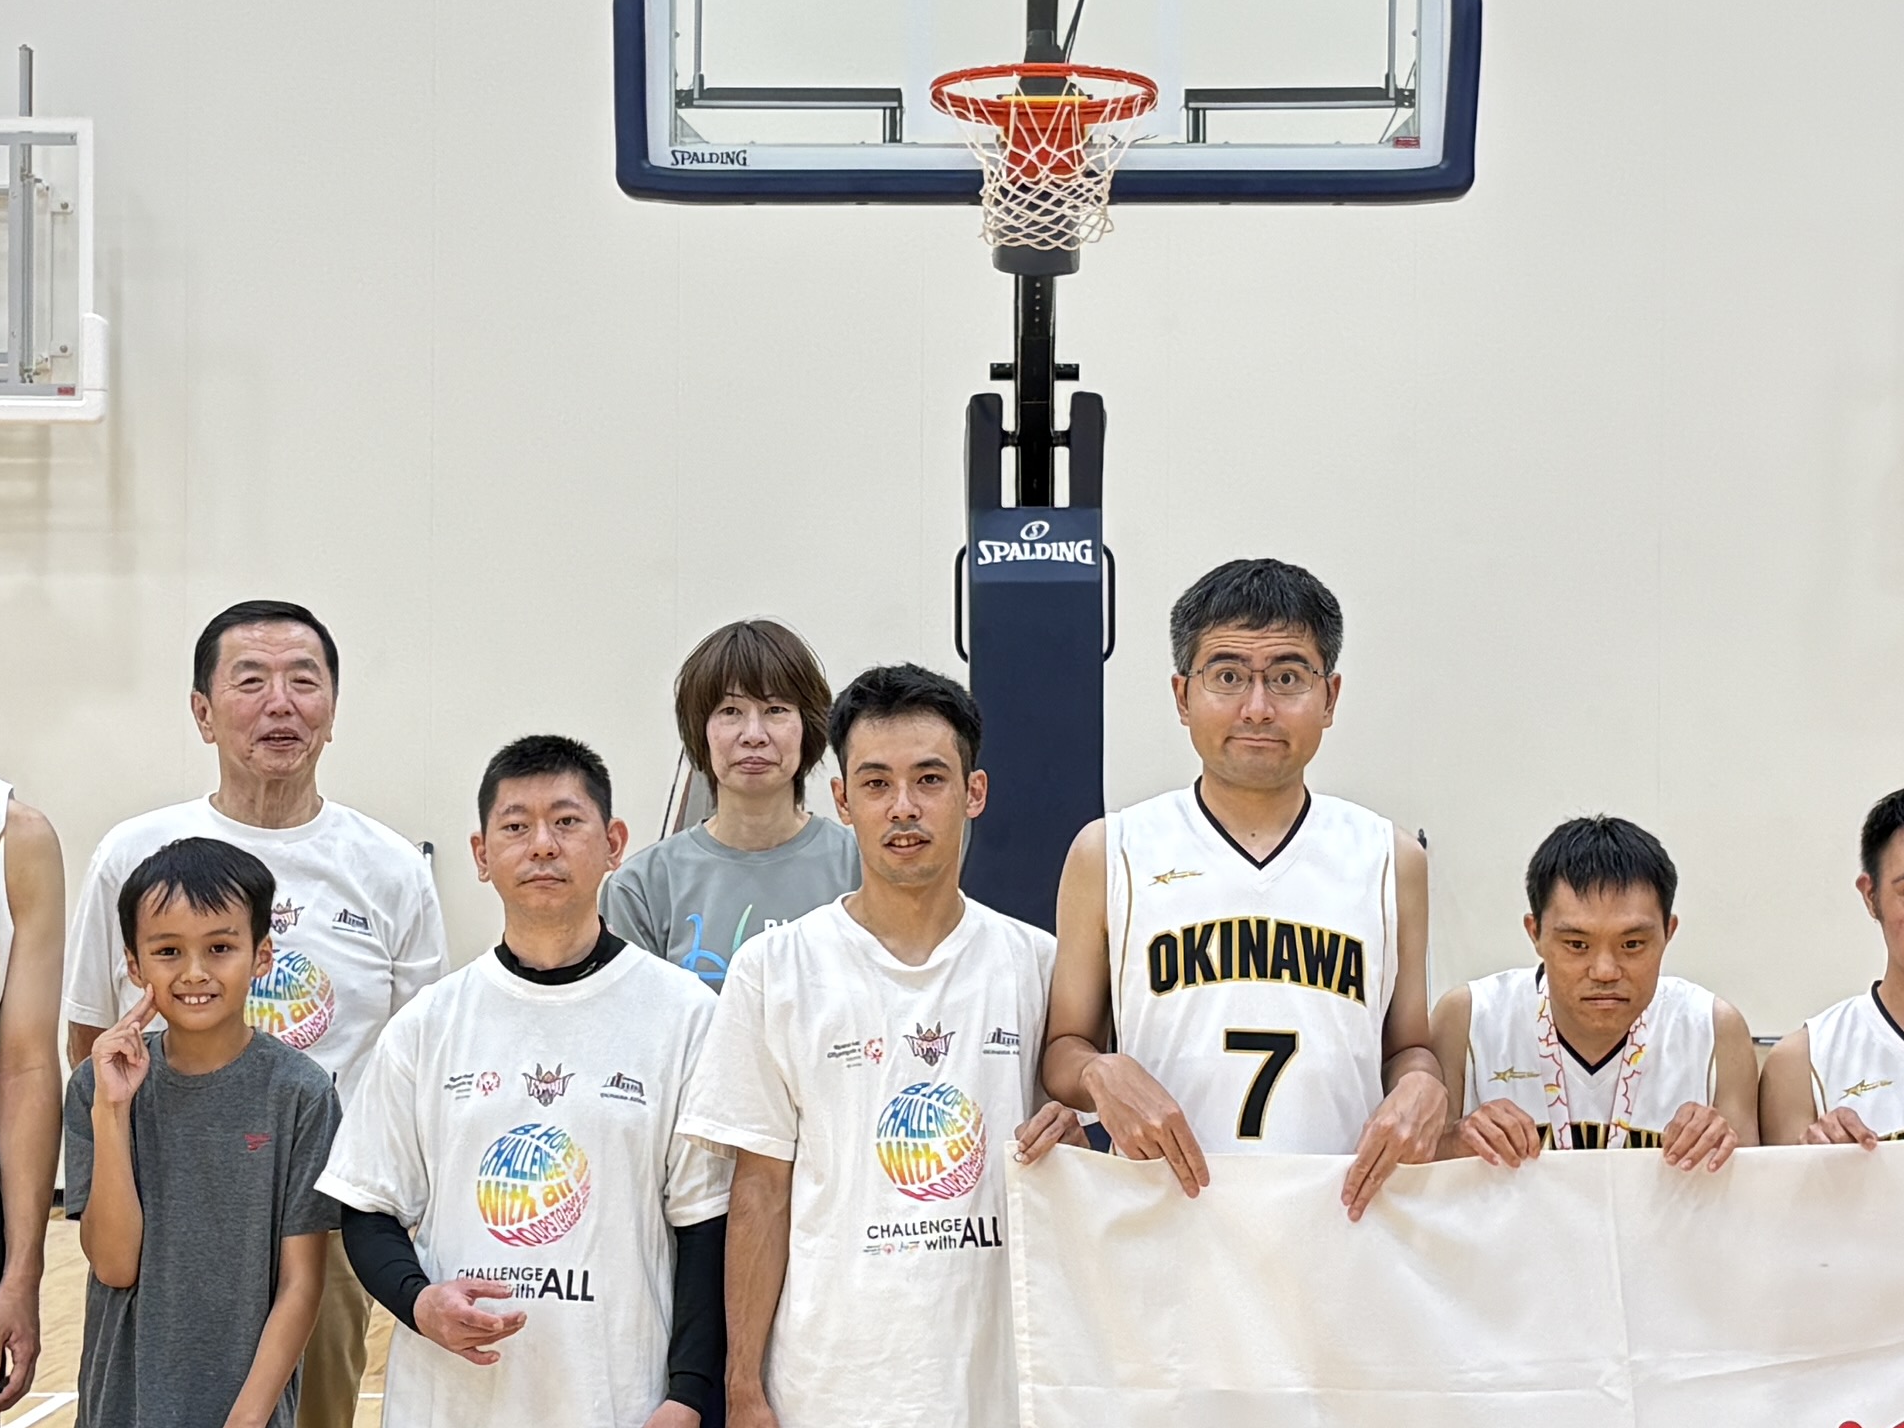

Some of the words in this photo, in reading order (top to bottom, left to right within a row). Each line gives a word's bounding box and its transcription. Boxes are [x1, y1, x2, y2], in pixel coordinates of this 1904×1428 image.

[670, 149, 748, 167] SPALDING
[977, 539, 1096, 565] SPALDING
[1147, 915, 1368, 1008] OKINAWA
[1222, 1027, 1299, 1140] 7
[867, 1217, 963, 1240] CHALLENGE
[959, 1215, 1003, 1249] ALL
[924, 1235, 957, 1251] with
[537, 1268, 595, 1302] ALL
